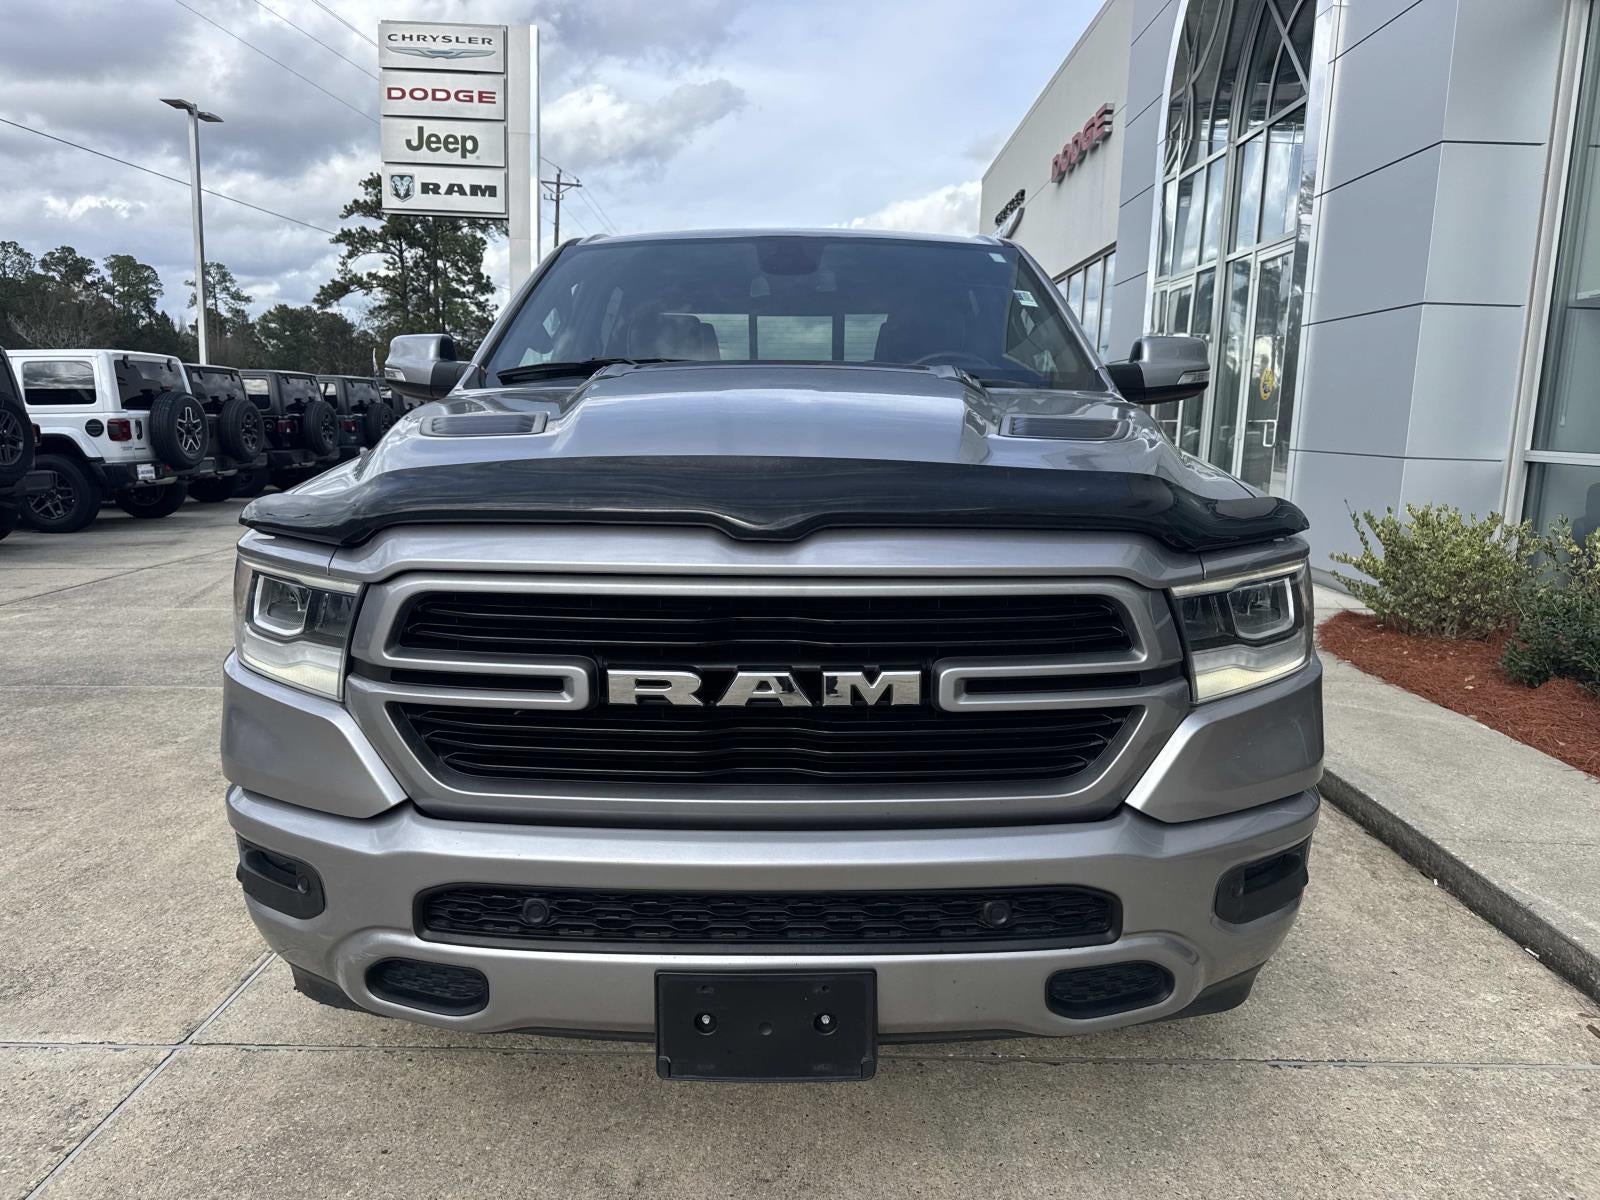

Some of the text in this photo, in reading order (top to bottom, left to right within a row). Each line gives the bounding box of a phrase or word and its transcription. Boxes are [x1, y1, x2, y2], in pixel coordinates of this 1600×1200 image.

[387, 34, 493, 45] CHRYSLER
[386, 87, 497, 104] DODGE
[405, 126, 479, 159] Jeep
[1051, 102, 1115, 183] DODGE
[420, 182, 497, 198] RAM
[607, 669, 922, 706] RAM
